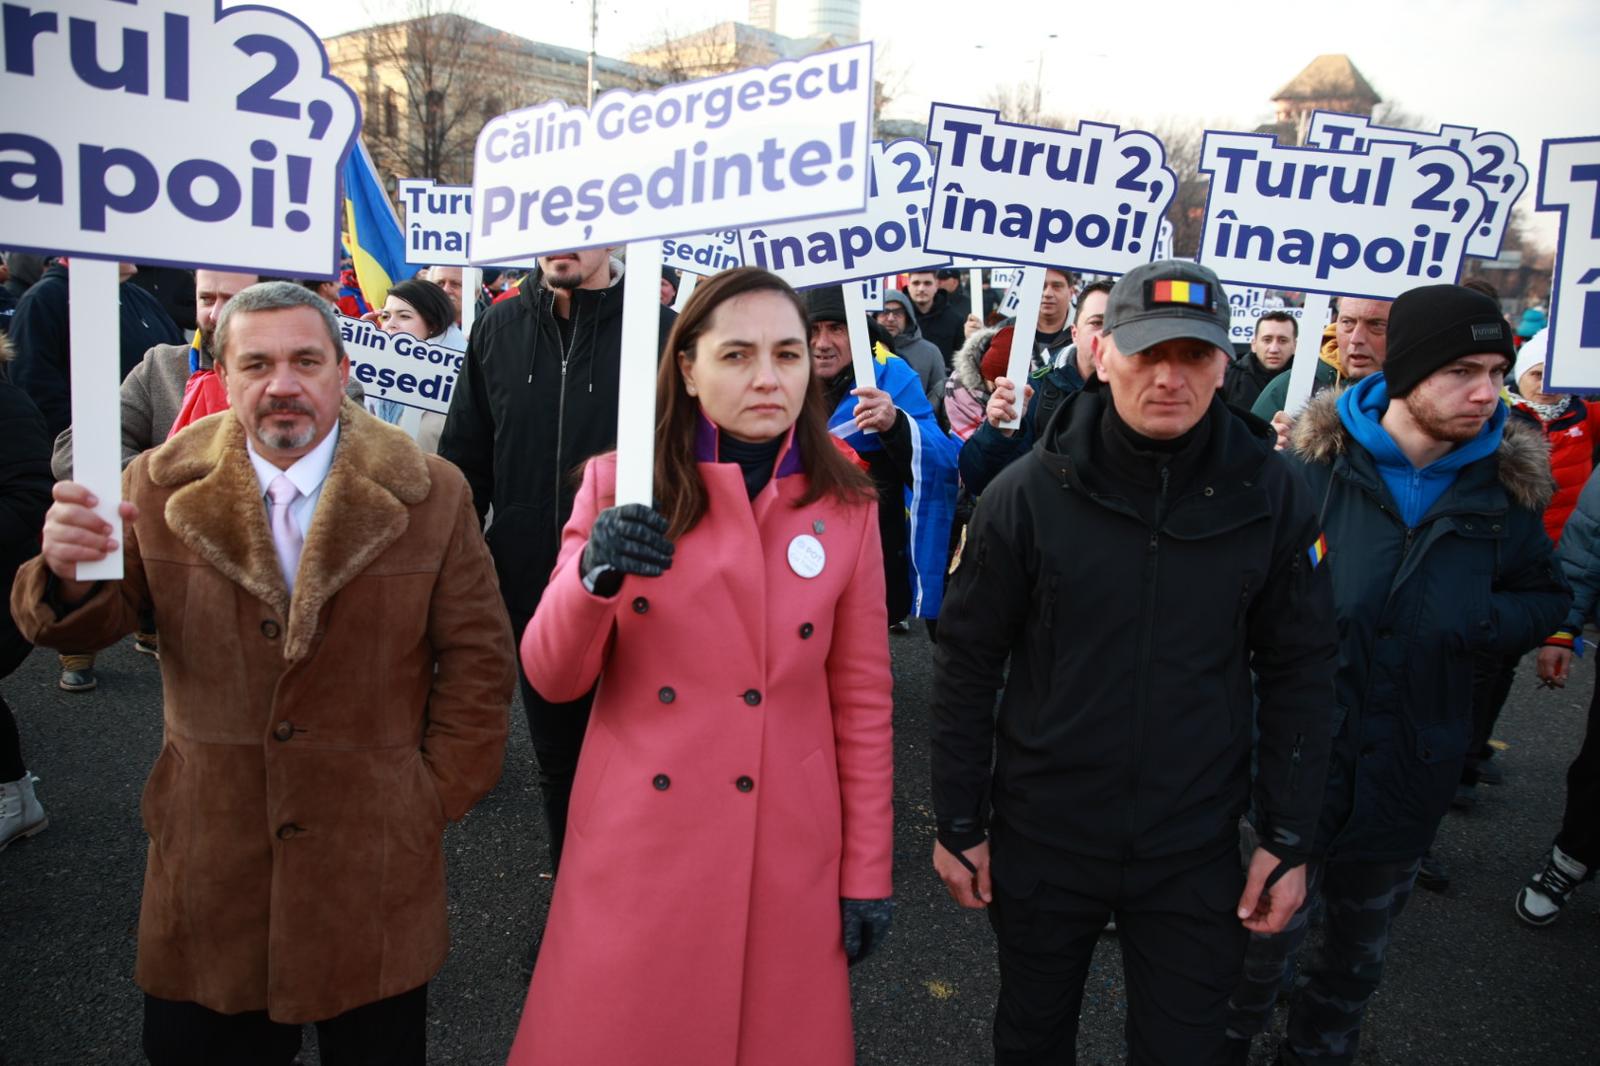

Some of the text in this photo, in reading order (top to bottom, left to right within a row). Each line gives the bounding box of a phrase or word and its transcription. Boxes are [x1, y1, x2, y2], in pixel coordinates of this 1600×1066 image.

[233, 33, 334, 141] 2,
[484, 59, 859, 163] Călin Georgescu
[482, 121, 856, 241] Președinte!
[943, 119, 1103, 185] Turul
[1115, 145, 1164, 203] 2,
[1216, 146, 1396, 207] Turul
[1411, 163, 1471, 223] 2,
[411, 222, 470, 259] îna
[942, 182, 1148, 253] înapoi!
[1214, 209, 1452, 280] înapoi!
